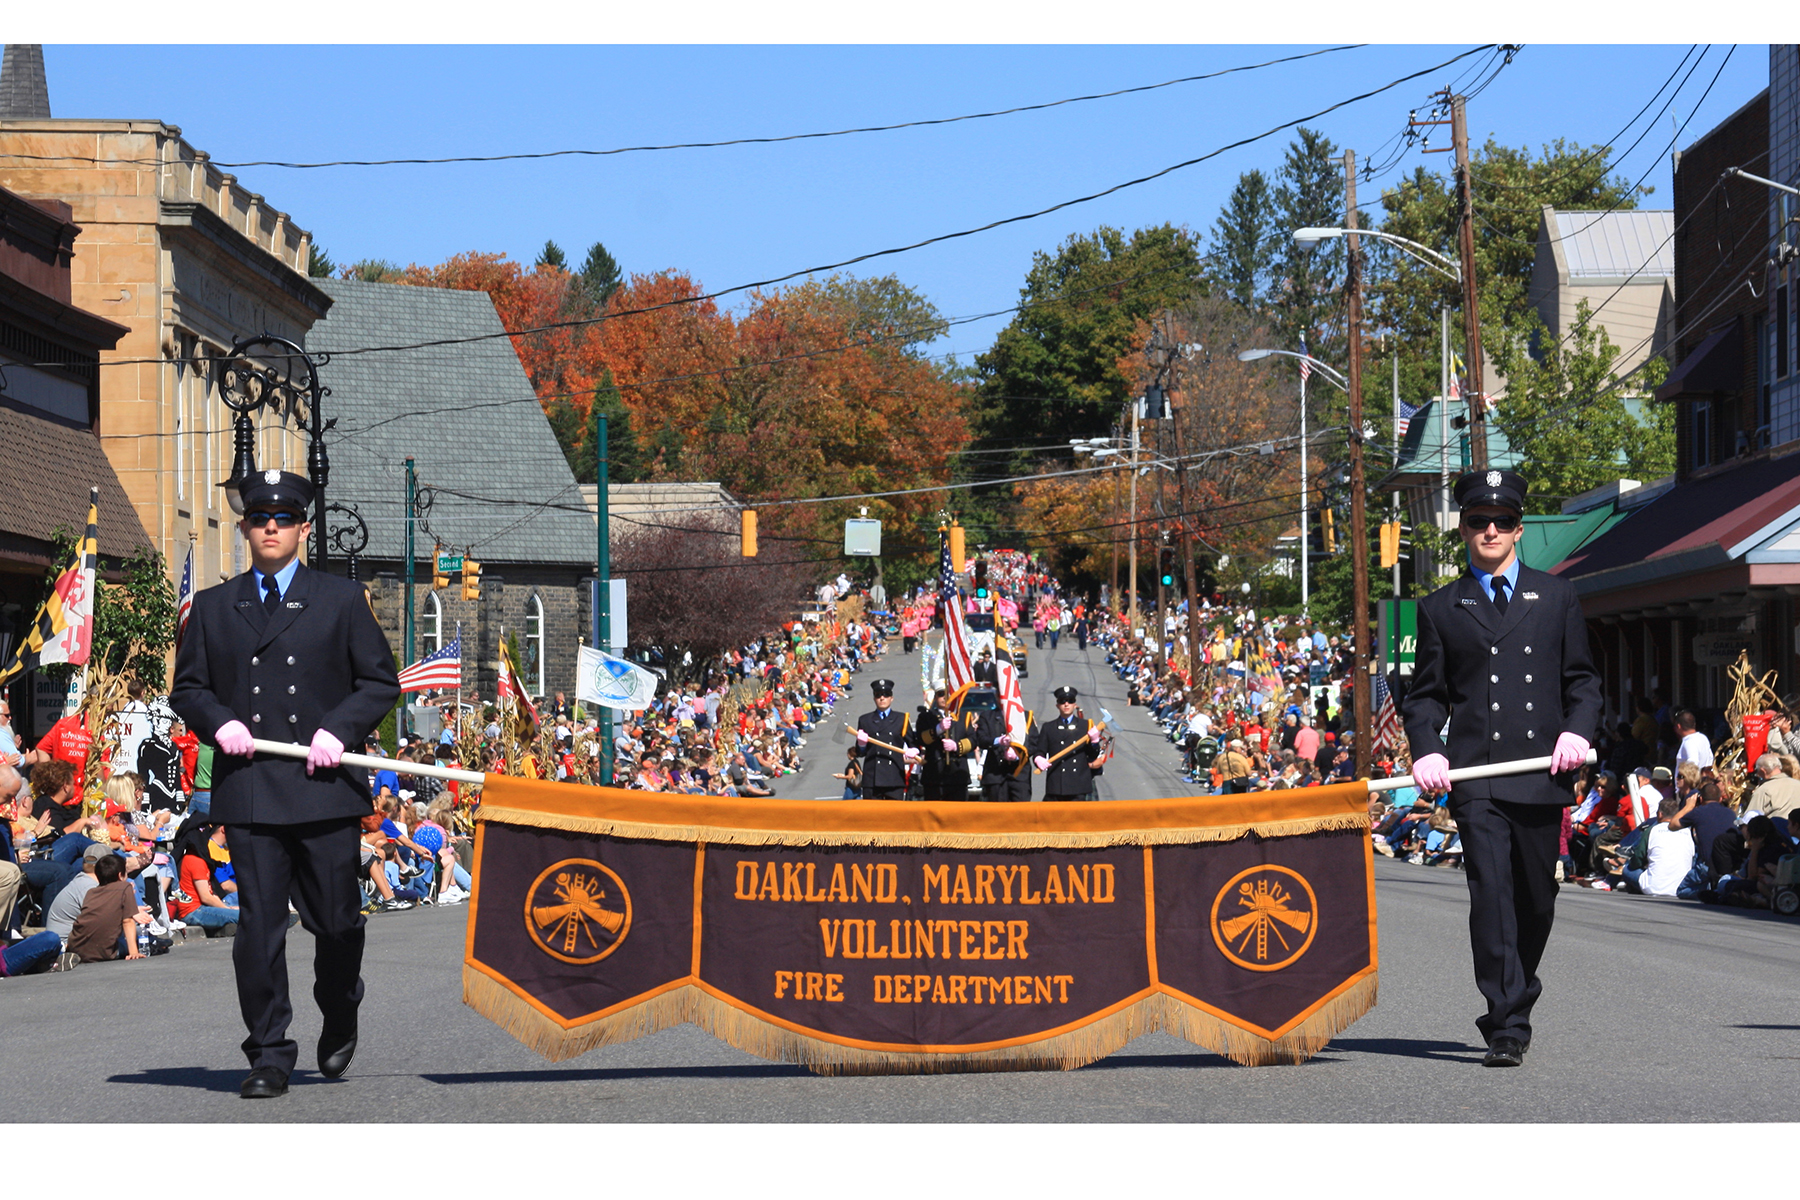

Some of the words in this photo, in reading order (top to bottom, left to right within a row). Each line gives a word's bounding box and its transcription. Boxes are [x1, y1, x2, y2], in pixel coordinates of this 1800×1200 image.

[1710, 648, 1756, 656] PHARMCY
[105, 722, 133, 736] PEN
[734, 860, 911, 905] OAKLAND,
[923, 863, 1115, 904] MARYLAND
[819, 918, 1029, 960] VOLUNTEER
[774, 970, 844, 1002] FIRE
[874, 975, 1074, 1004] DEPARTMENT
